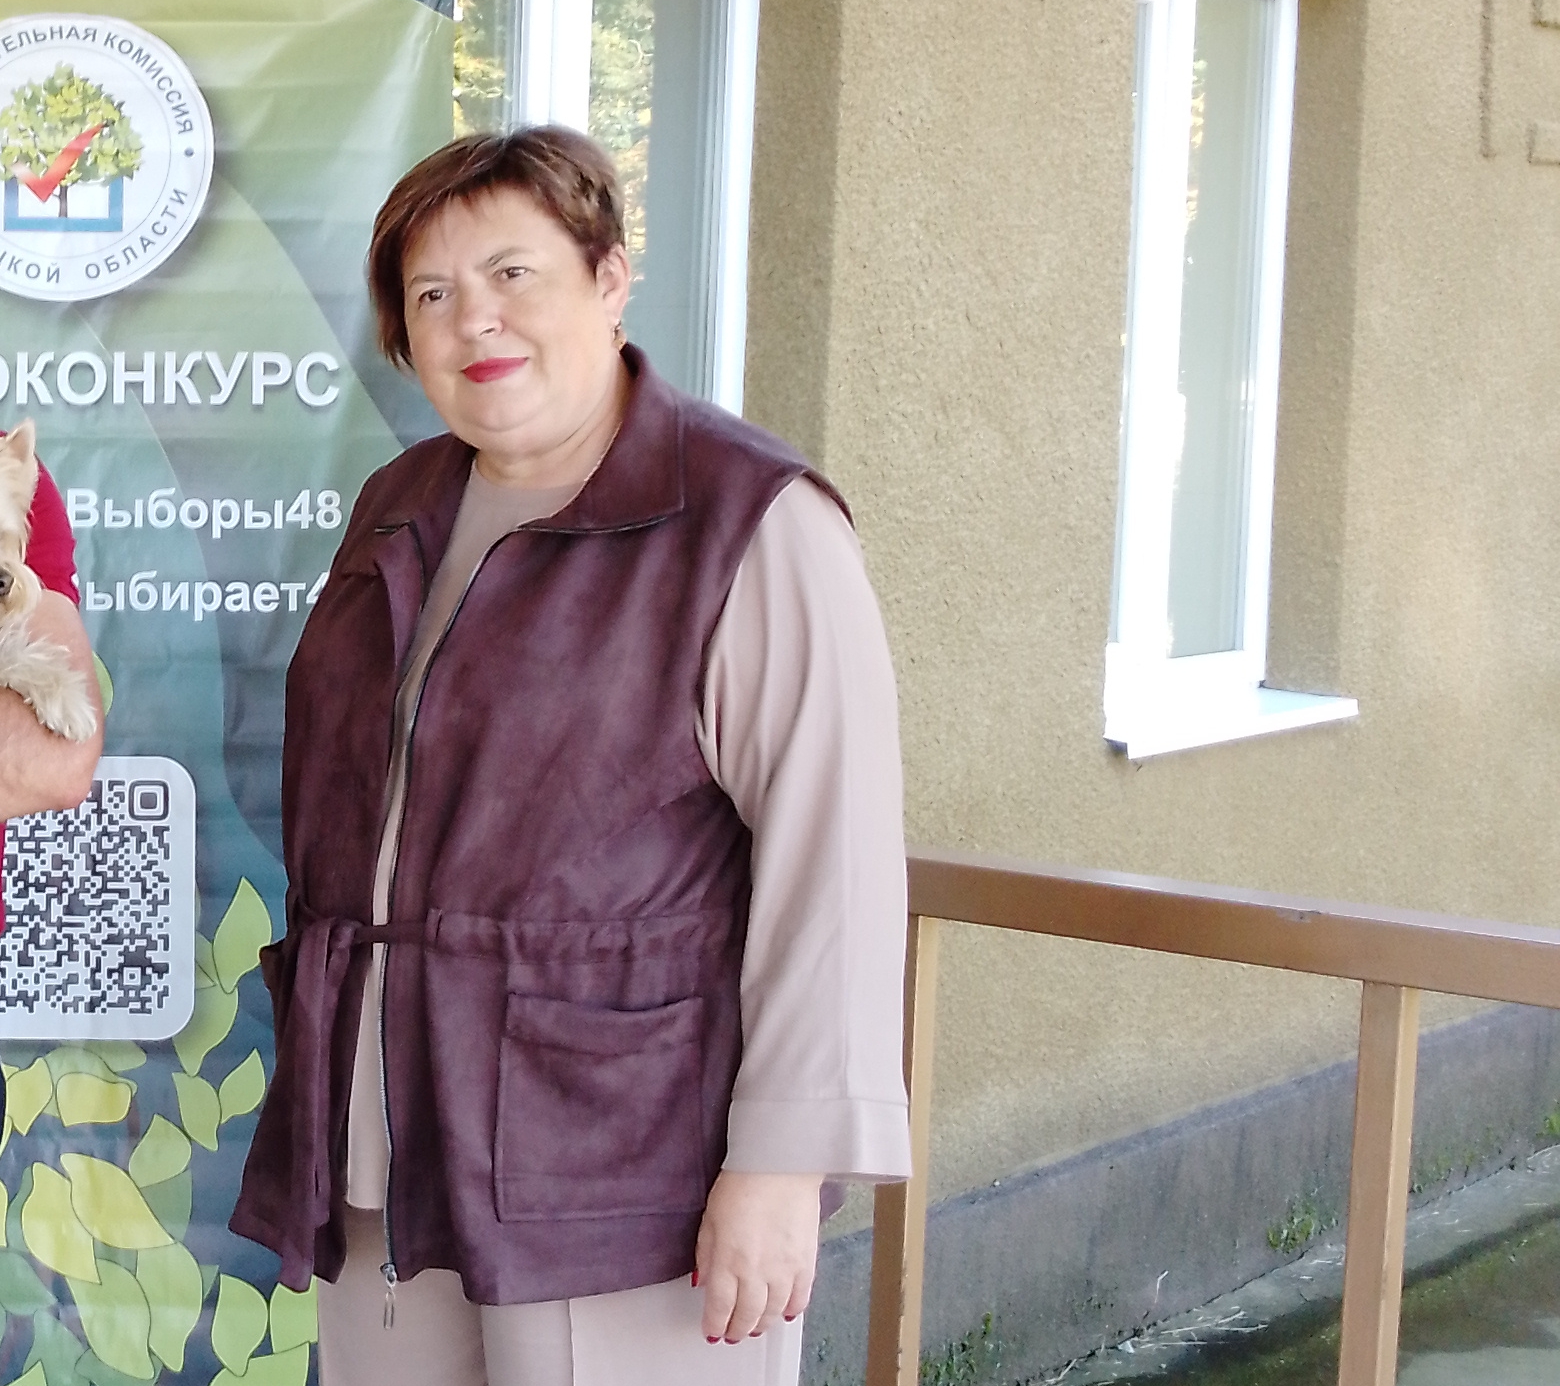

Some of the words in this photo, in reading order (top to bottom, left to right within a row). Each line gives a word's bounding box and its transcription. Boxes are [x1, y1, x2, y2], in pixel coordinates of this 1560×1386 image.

[102, 28, 195, 136] КОМИССИЯ
[84, 187, 188, 281] ОБЛАСТИ
[67, 488, 343, 539] Выборы48
